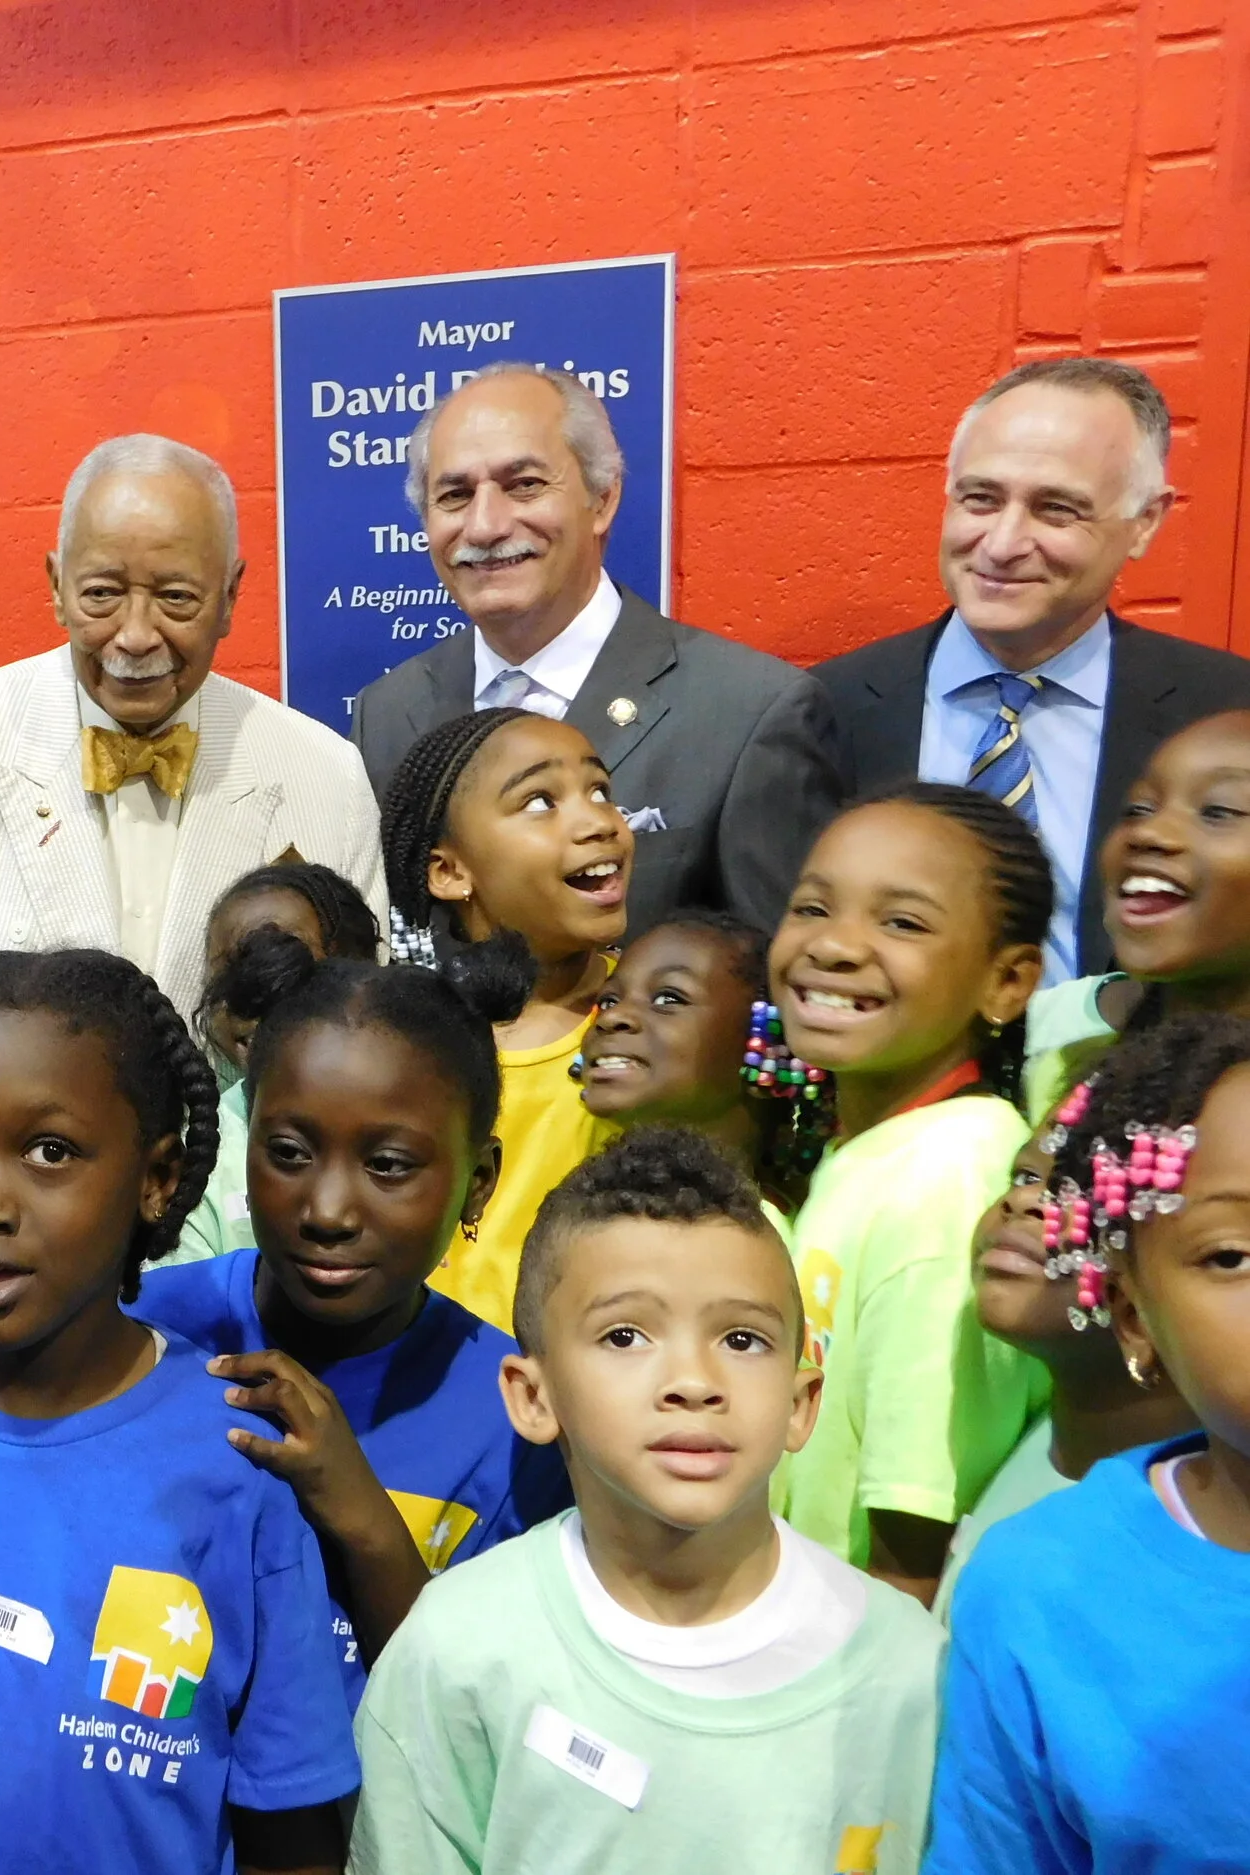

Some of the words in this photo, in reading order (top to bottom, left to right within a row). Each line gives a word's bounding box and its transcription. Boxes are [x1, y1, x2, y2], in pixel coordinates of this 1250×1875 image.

[418, 320, 514, 352] Mayor
[311, 371, 436, 418] David
[368, 524, 430, 553] The
[323, 587, 343, 608] A
[350, 584, 461, 613] Beginnin
[391, 617, 428, 640] for
[58, 1713, 117, 1739] Harlem
[120, 1723, 200, 1756] Children's
[82, 1744, 182, 1784] ZONE
